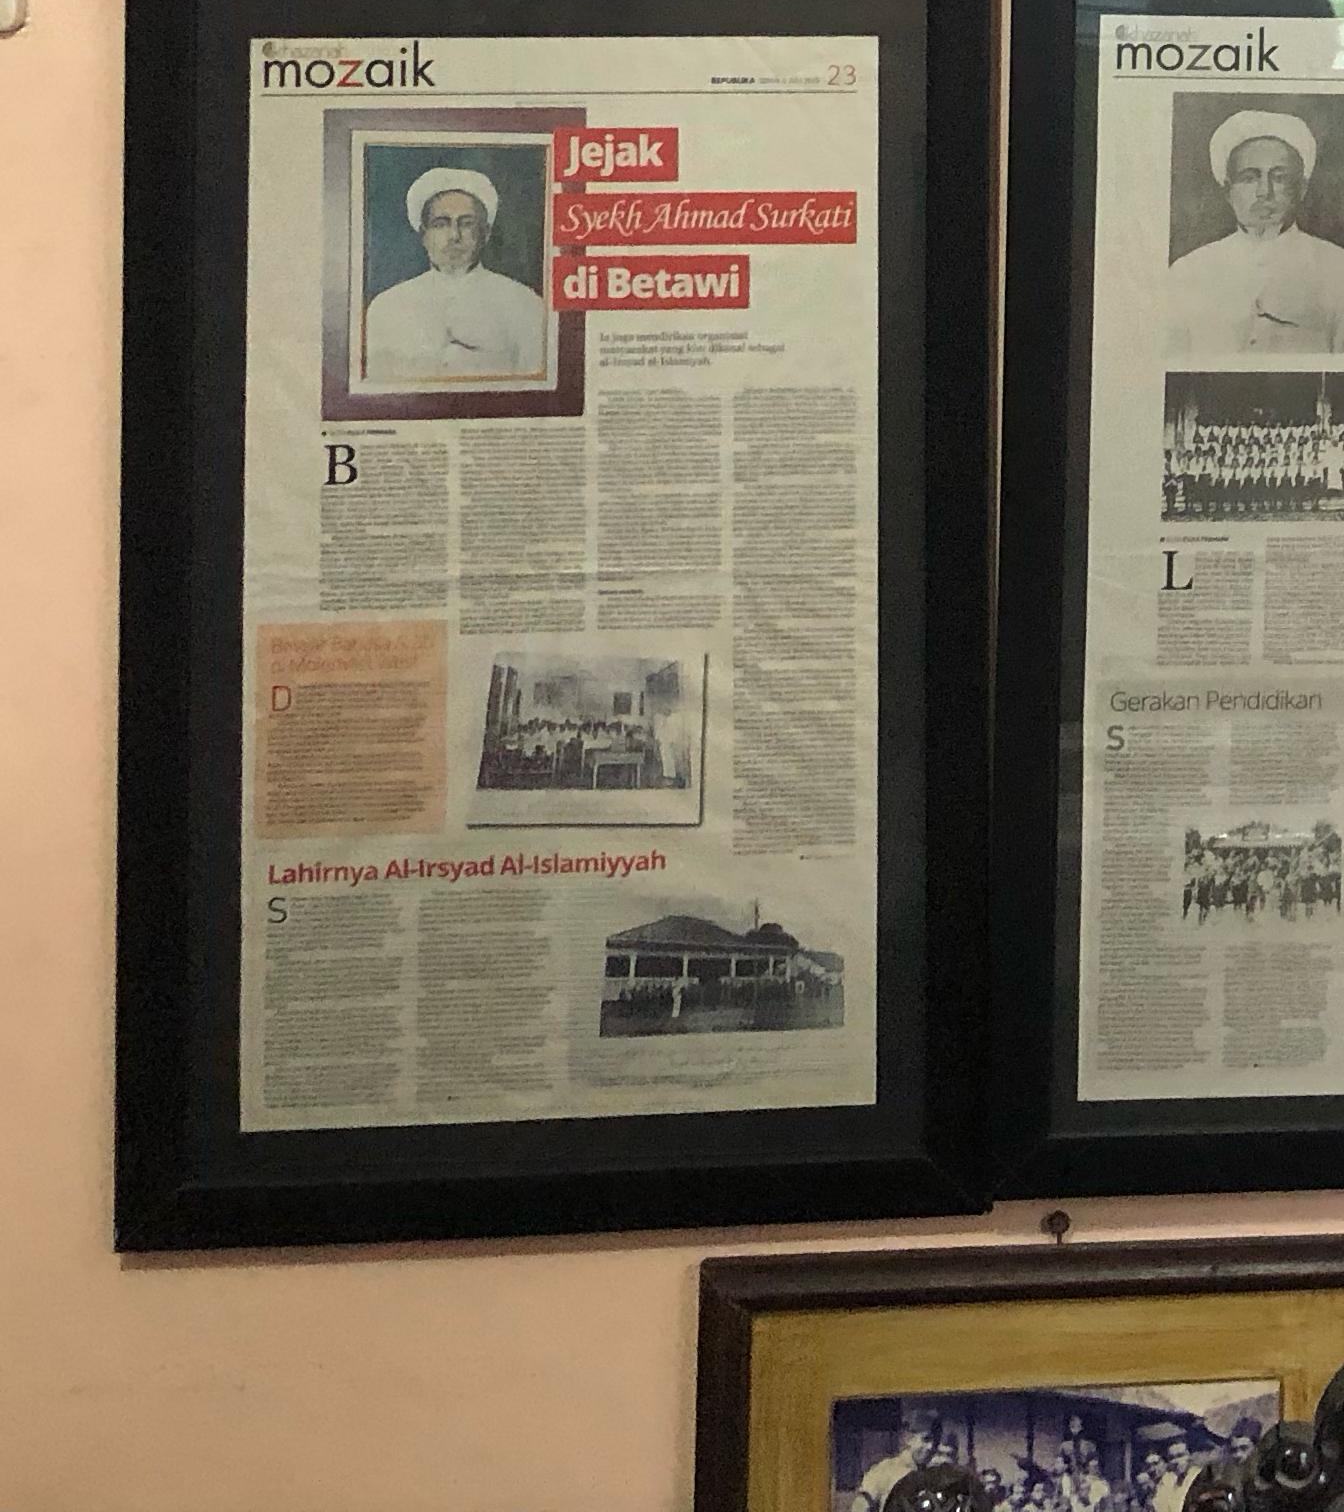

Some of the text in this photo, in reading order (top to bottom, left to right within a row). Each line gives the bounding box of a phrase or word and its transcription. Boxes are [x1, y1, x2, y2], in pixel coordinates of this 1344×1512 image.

[264, 40, 435, 88] mozaik
[827, 64, 857, 86] 23
[1117, 26, 1279, 71] mozaik
[563, 134, 663, 177] Jejak
[560, 197, 854, 241] Syekh Ahmad Surkati
[562, 263, 740, 300] di Betawi
[322, 443, 358, 486] B
[1160, 549, 1193, 590] L
[1109, 688, 1323, 712] Gerakan Pendidikan
[267, 849, 666, 888] Lahirnya Al-Irsyad Al-Islamiyyah
